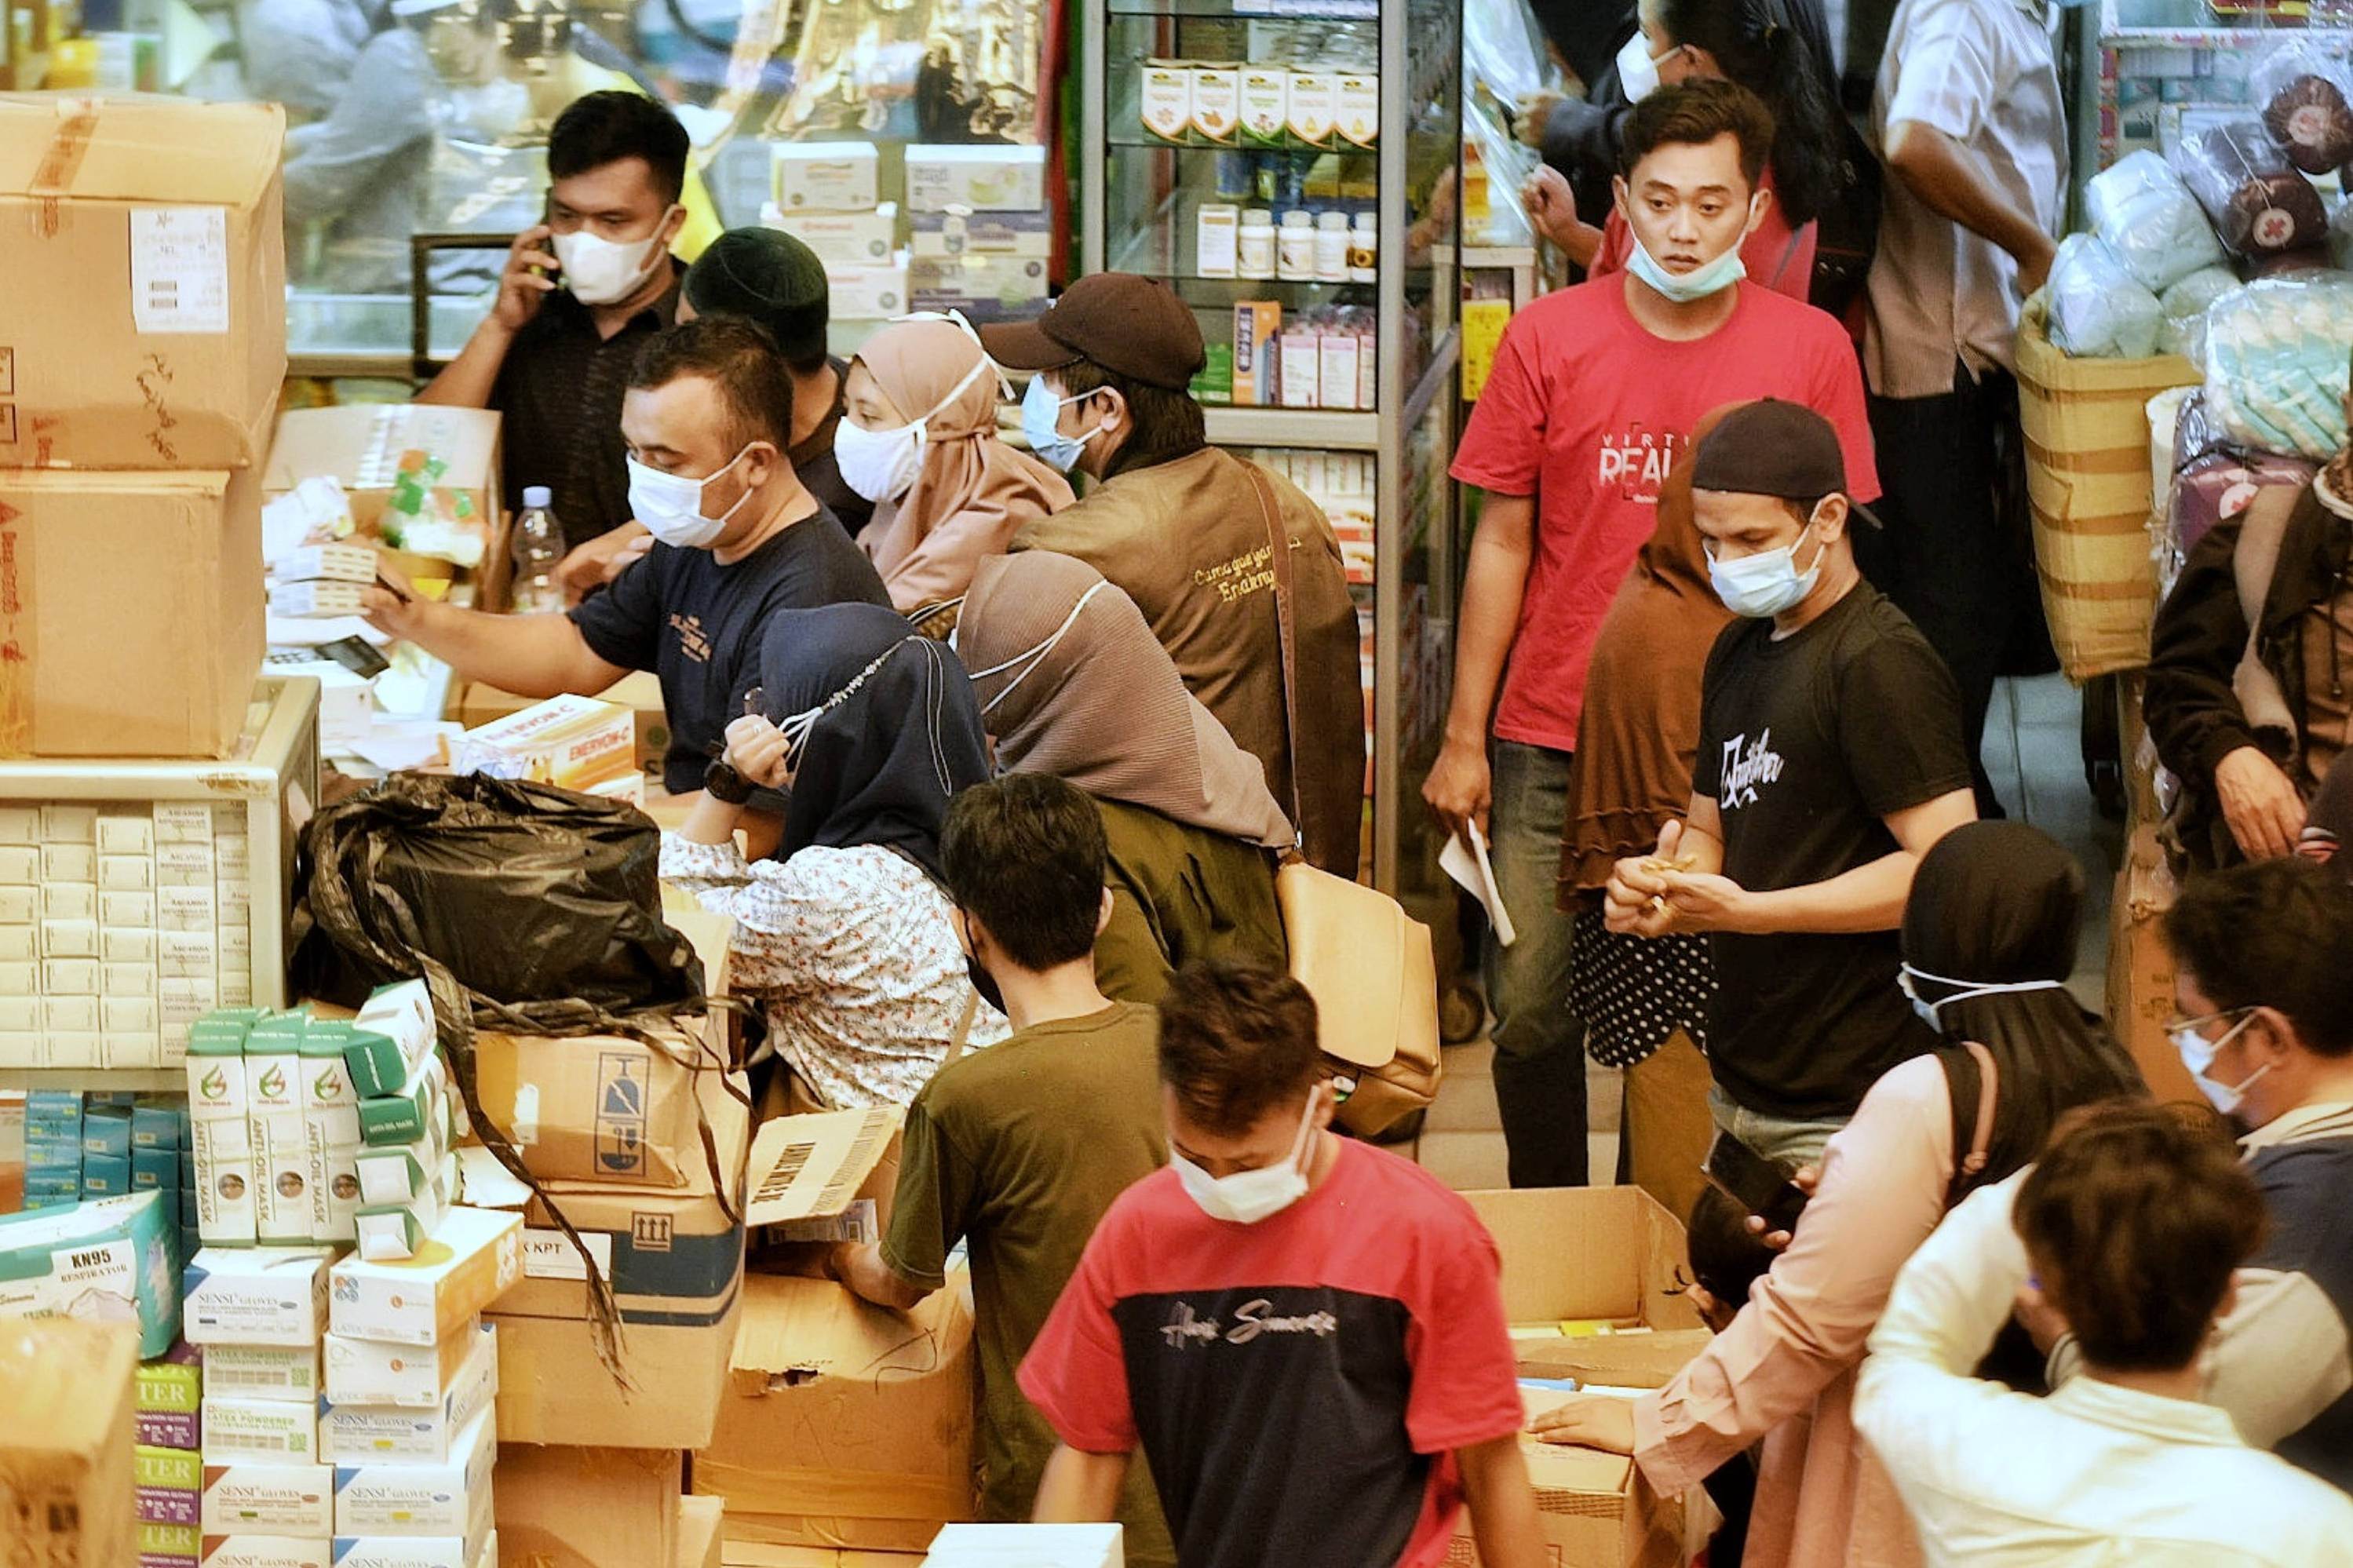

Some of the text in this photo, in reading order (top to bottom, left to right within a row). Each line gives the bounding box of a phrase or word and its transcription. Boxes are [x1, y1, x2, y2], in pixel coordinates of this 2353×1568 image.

[199, 1185, 213, 1224] MASK
[256, 1185, 270, 1223] MASK
[312, 1186, 326, 1224] MASK
[71, 1248, 111, 1269] KN95
[139, 1381, 186, 1402] TER
[139, 1460, 192, 1481] TER
